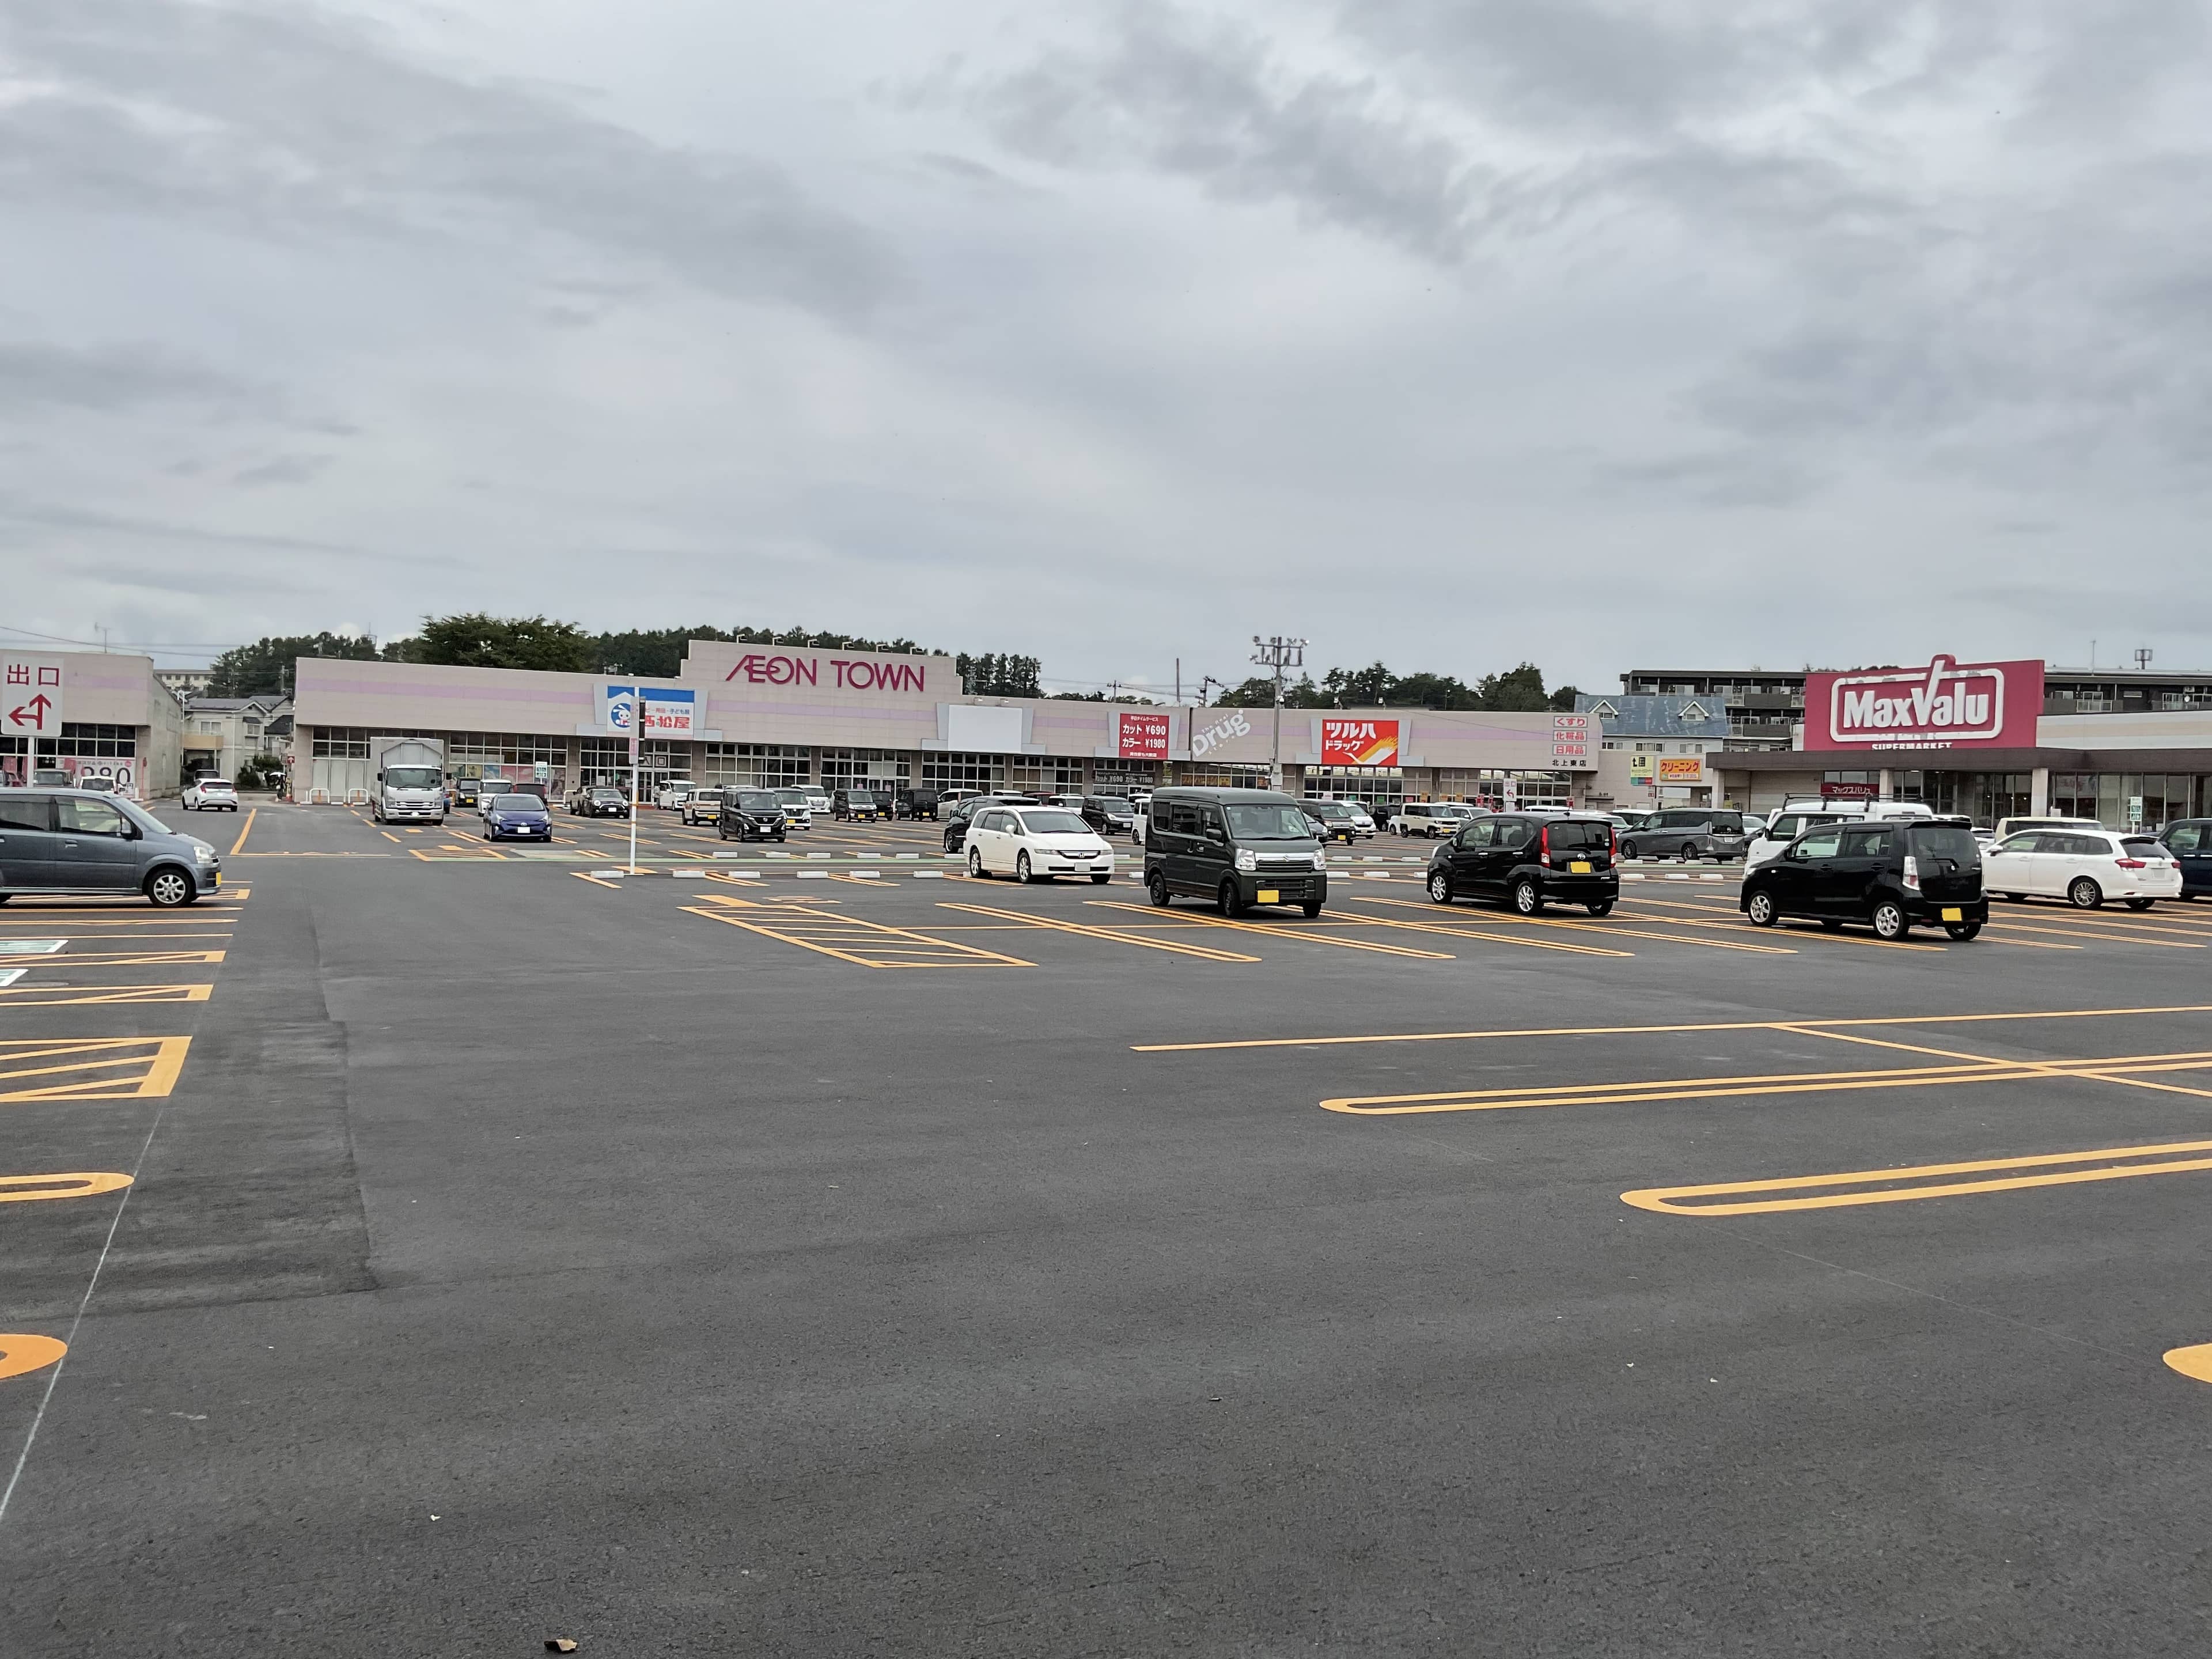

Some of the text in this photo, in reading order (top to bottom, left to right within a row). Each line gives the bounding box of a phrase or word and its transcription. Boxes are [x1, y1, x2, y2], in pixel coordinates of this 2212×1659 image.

[7, 664, 59, 687] 出口
[830, 660, 925, 691] TOWN
[1843, 660, 1989, 728] MaxValu
[1557, 717, 1585, 726] くすり
[1122, 724, 1166, 736] カット ¥690
[1192, 709, 1251, 757] Drug
[1326, 722, 1376, 739] ツルハ
[1556, 732, 1584, 740] 化粧品
[1122, 737, 1166, 749] カラー ¥1980
[1325, 740, 1364, 751] ドラッグ
[1556, 746, 1584, 754] 日用品
[1661, 760, 1700, 772] クリーニング
